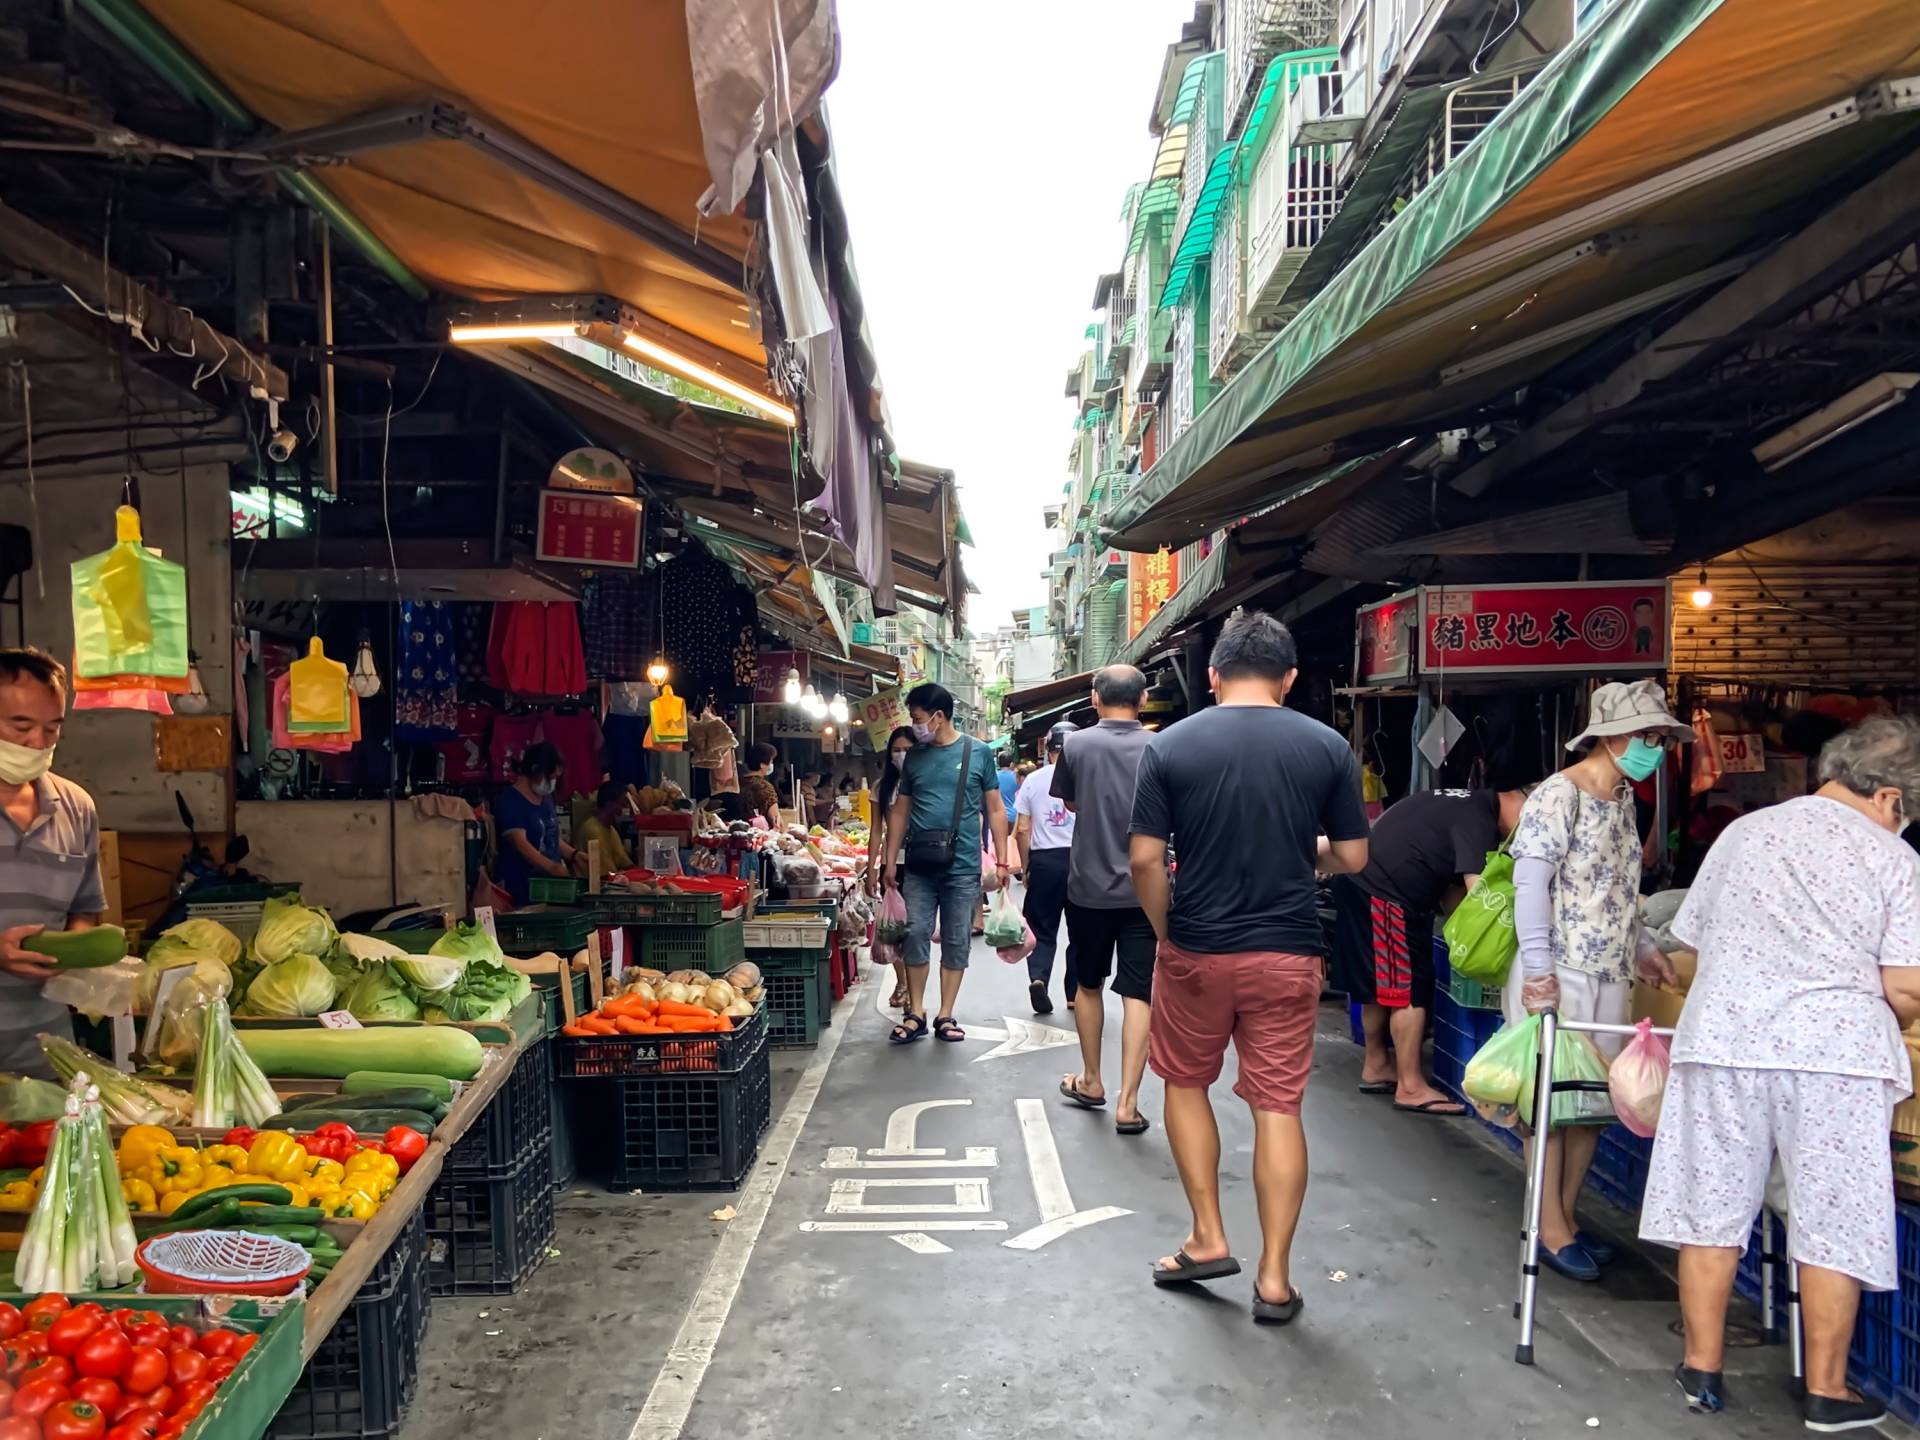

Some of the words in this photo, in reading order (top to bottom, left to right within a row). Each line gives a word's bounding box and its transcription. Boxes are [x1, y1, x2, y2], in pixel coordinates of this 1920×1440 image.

[1146, 546, 1172, 617] 雜糧
[1723, 740, 1748, 760] 30
[330, 1012, 351, 1029] 50
